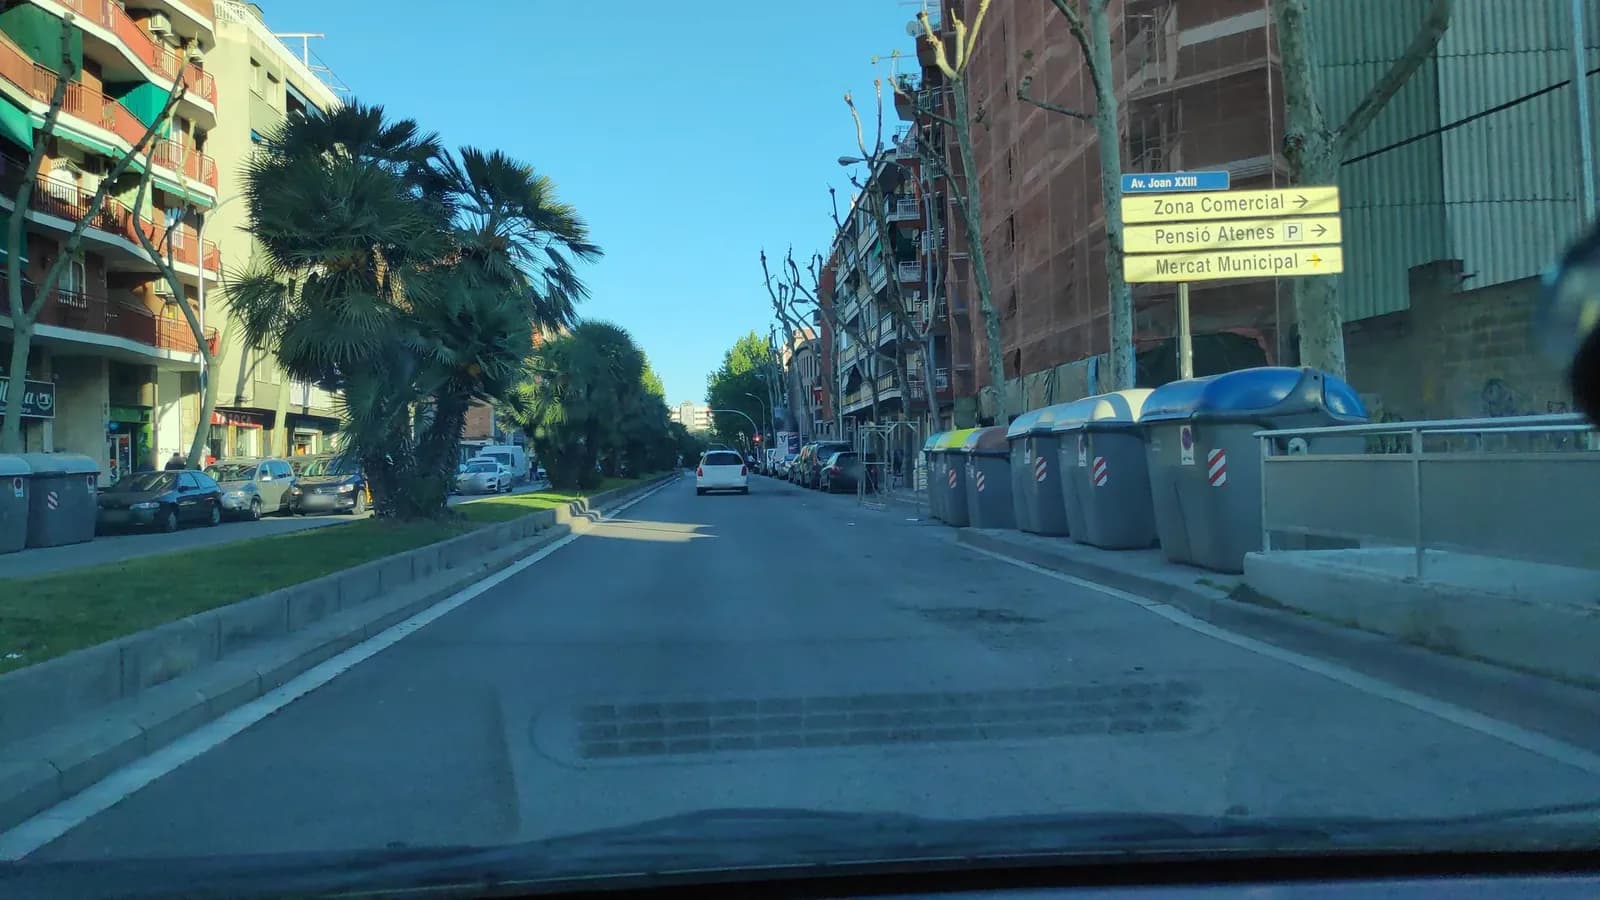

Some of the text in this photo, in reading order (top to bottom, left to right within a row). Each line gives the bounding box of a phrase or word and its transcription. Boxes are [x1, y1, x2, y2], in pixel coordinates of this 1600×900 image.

[1131, 176, 1197, 188] Av. Joan XXIII
[1154, 194, 1284, 215] Zona Comercial
[1155, 225, 1298, 245] Pensió Atenes P
[1156, 252, 1298, 275] Mercat Municipal
